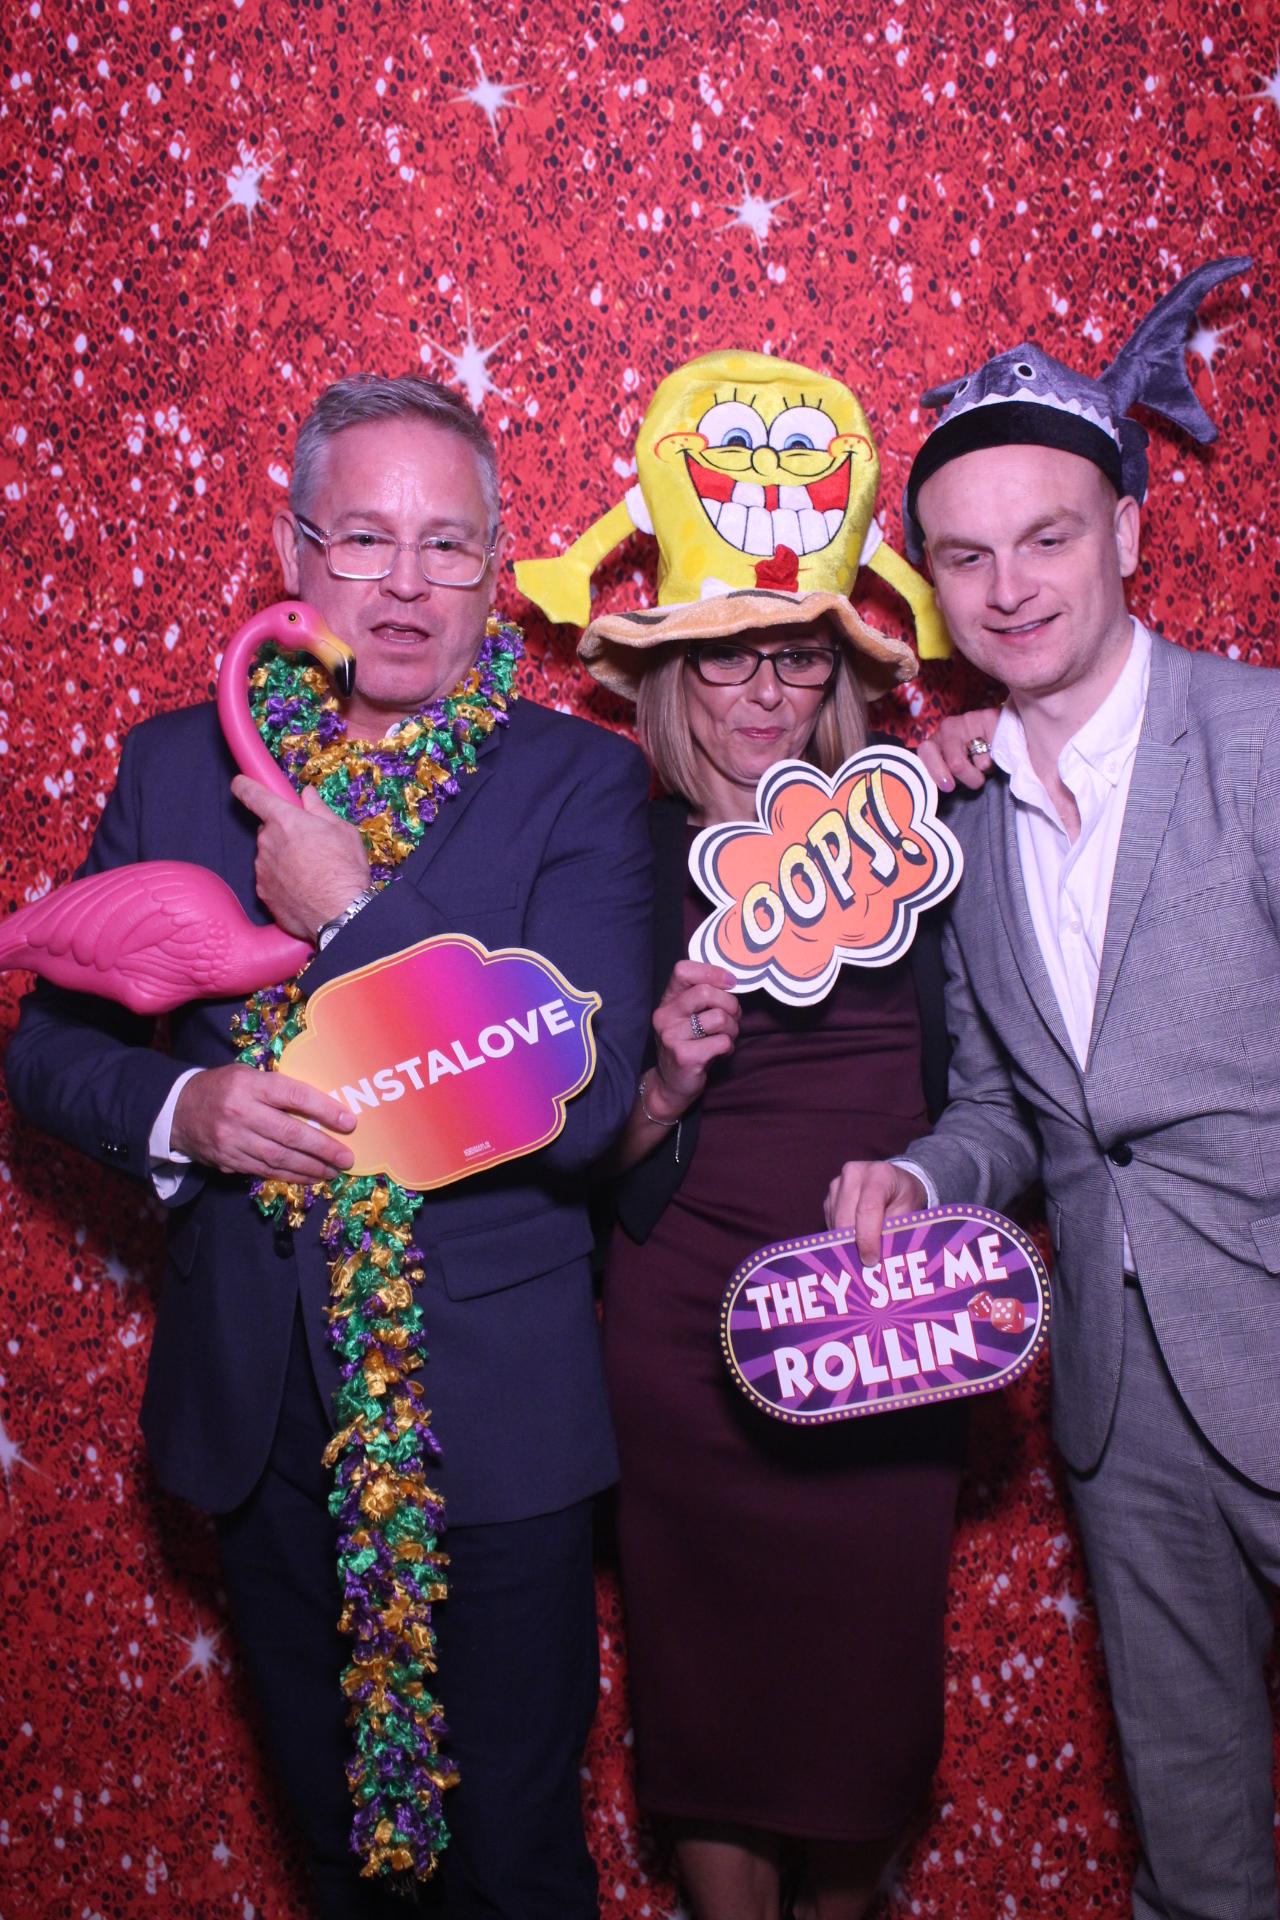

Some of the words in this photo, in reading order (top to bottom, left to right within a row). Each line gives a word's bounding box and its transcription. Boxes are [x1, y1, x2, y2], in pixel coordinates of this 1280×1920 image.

[742, 763, 926, 952] OOPS!
[328, 998, 576, 1115] NSTALOVE
[745, 1269, 852, 1331] THEY
[861, 1249, 935, 1309] SEE
[942, 1233, 1008, 1290] ME
[773, 1310, 979, 1399] ROLLIN
